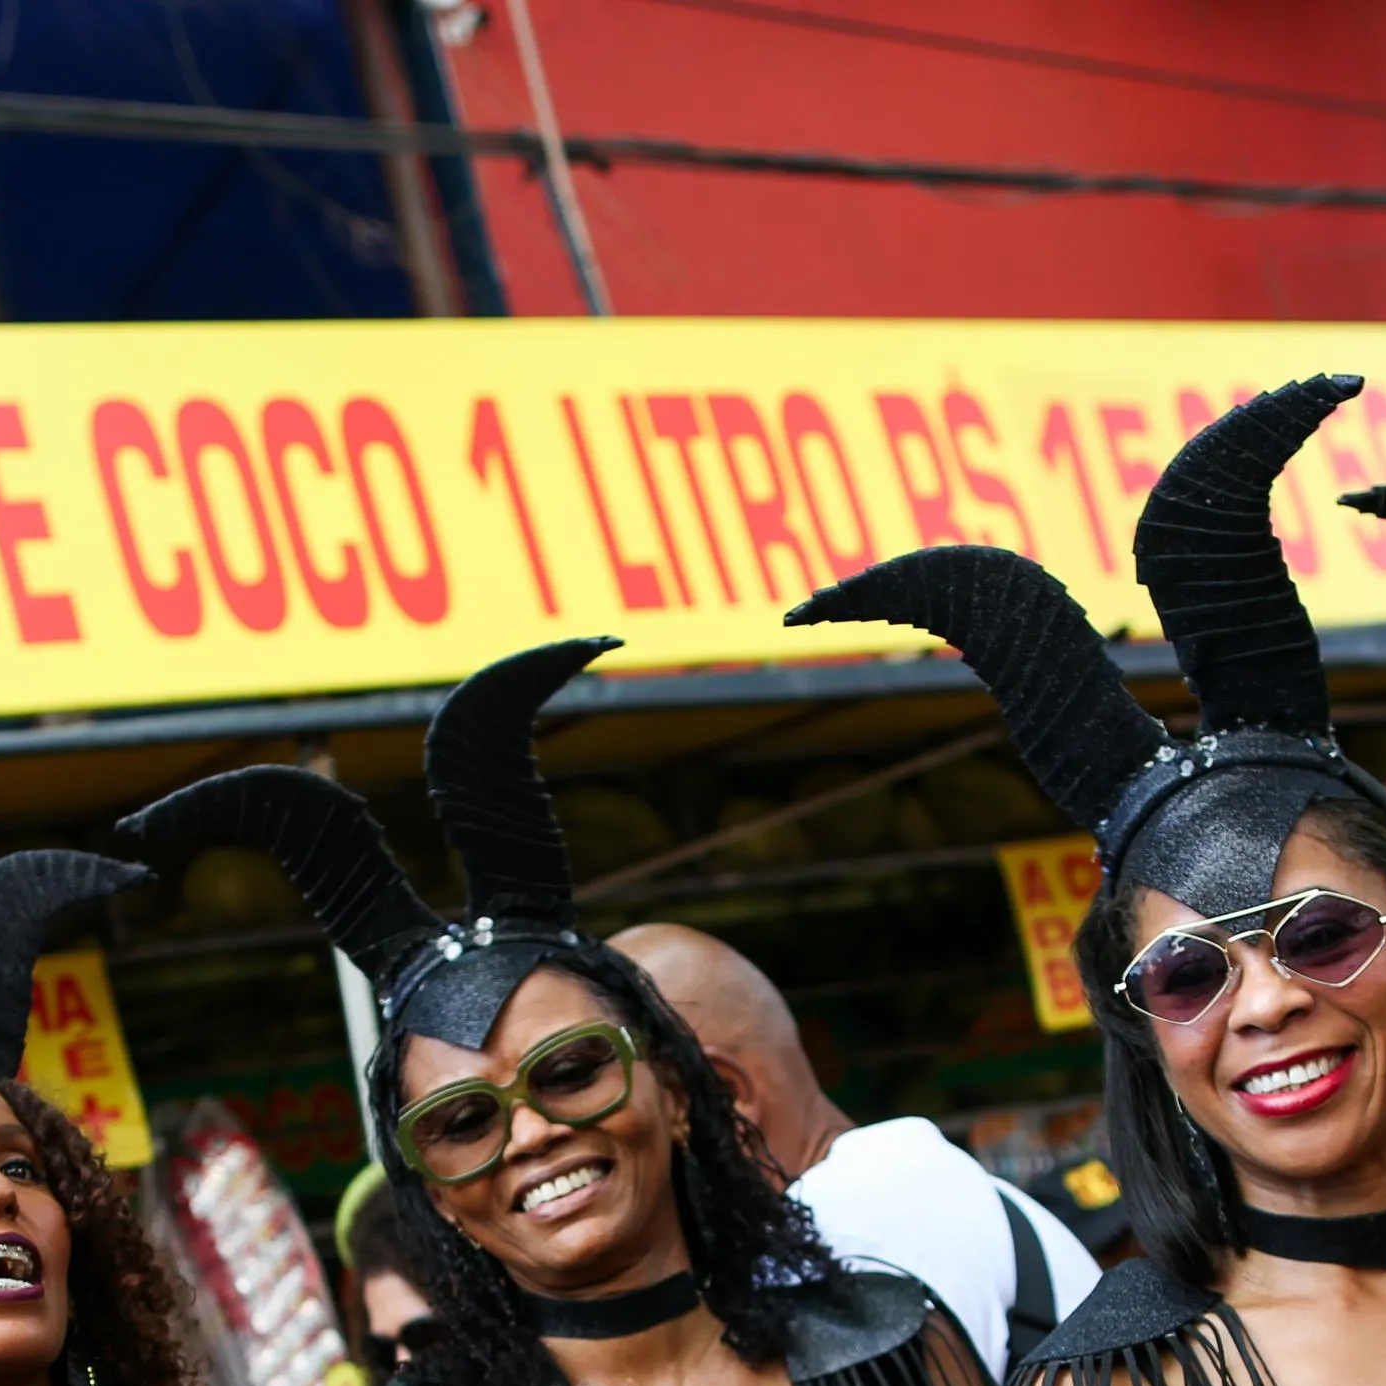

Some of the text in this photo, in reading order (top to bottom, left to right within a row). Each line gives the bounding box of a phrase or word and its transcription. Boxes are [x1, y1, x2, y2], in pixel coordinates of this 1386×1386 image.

[89, 393, 452, 638] COCO
[467, 394, 560, 617] 1
[559, 391, 877, 612] LITRO
